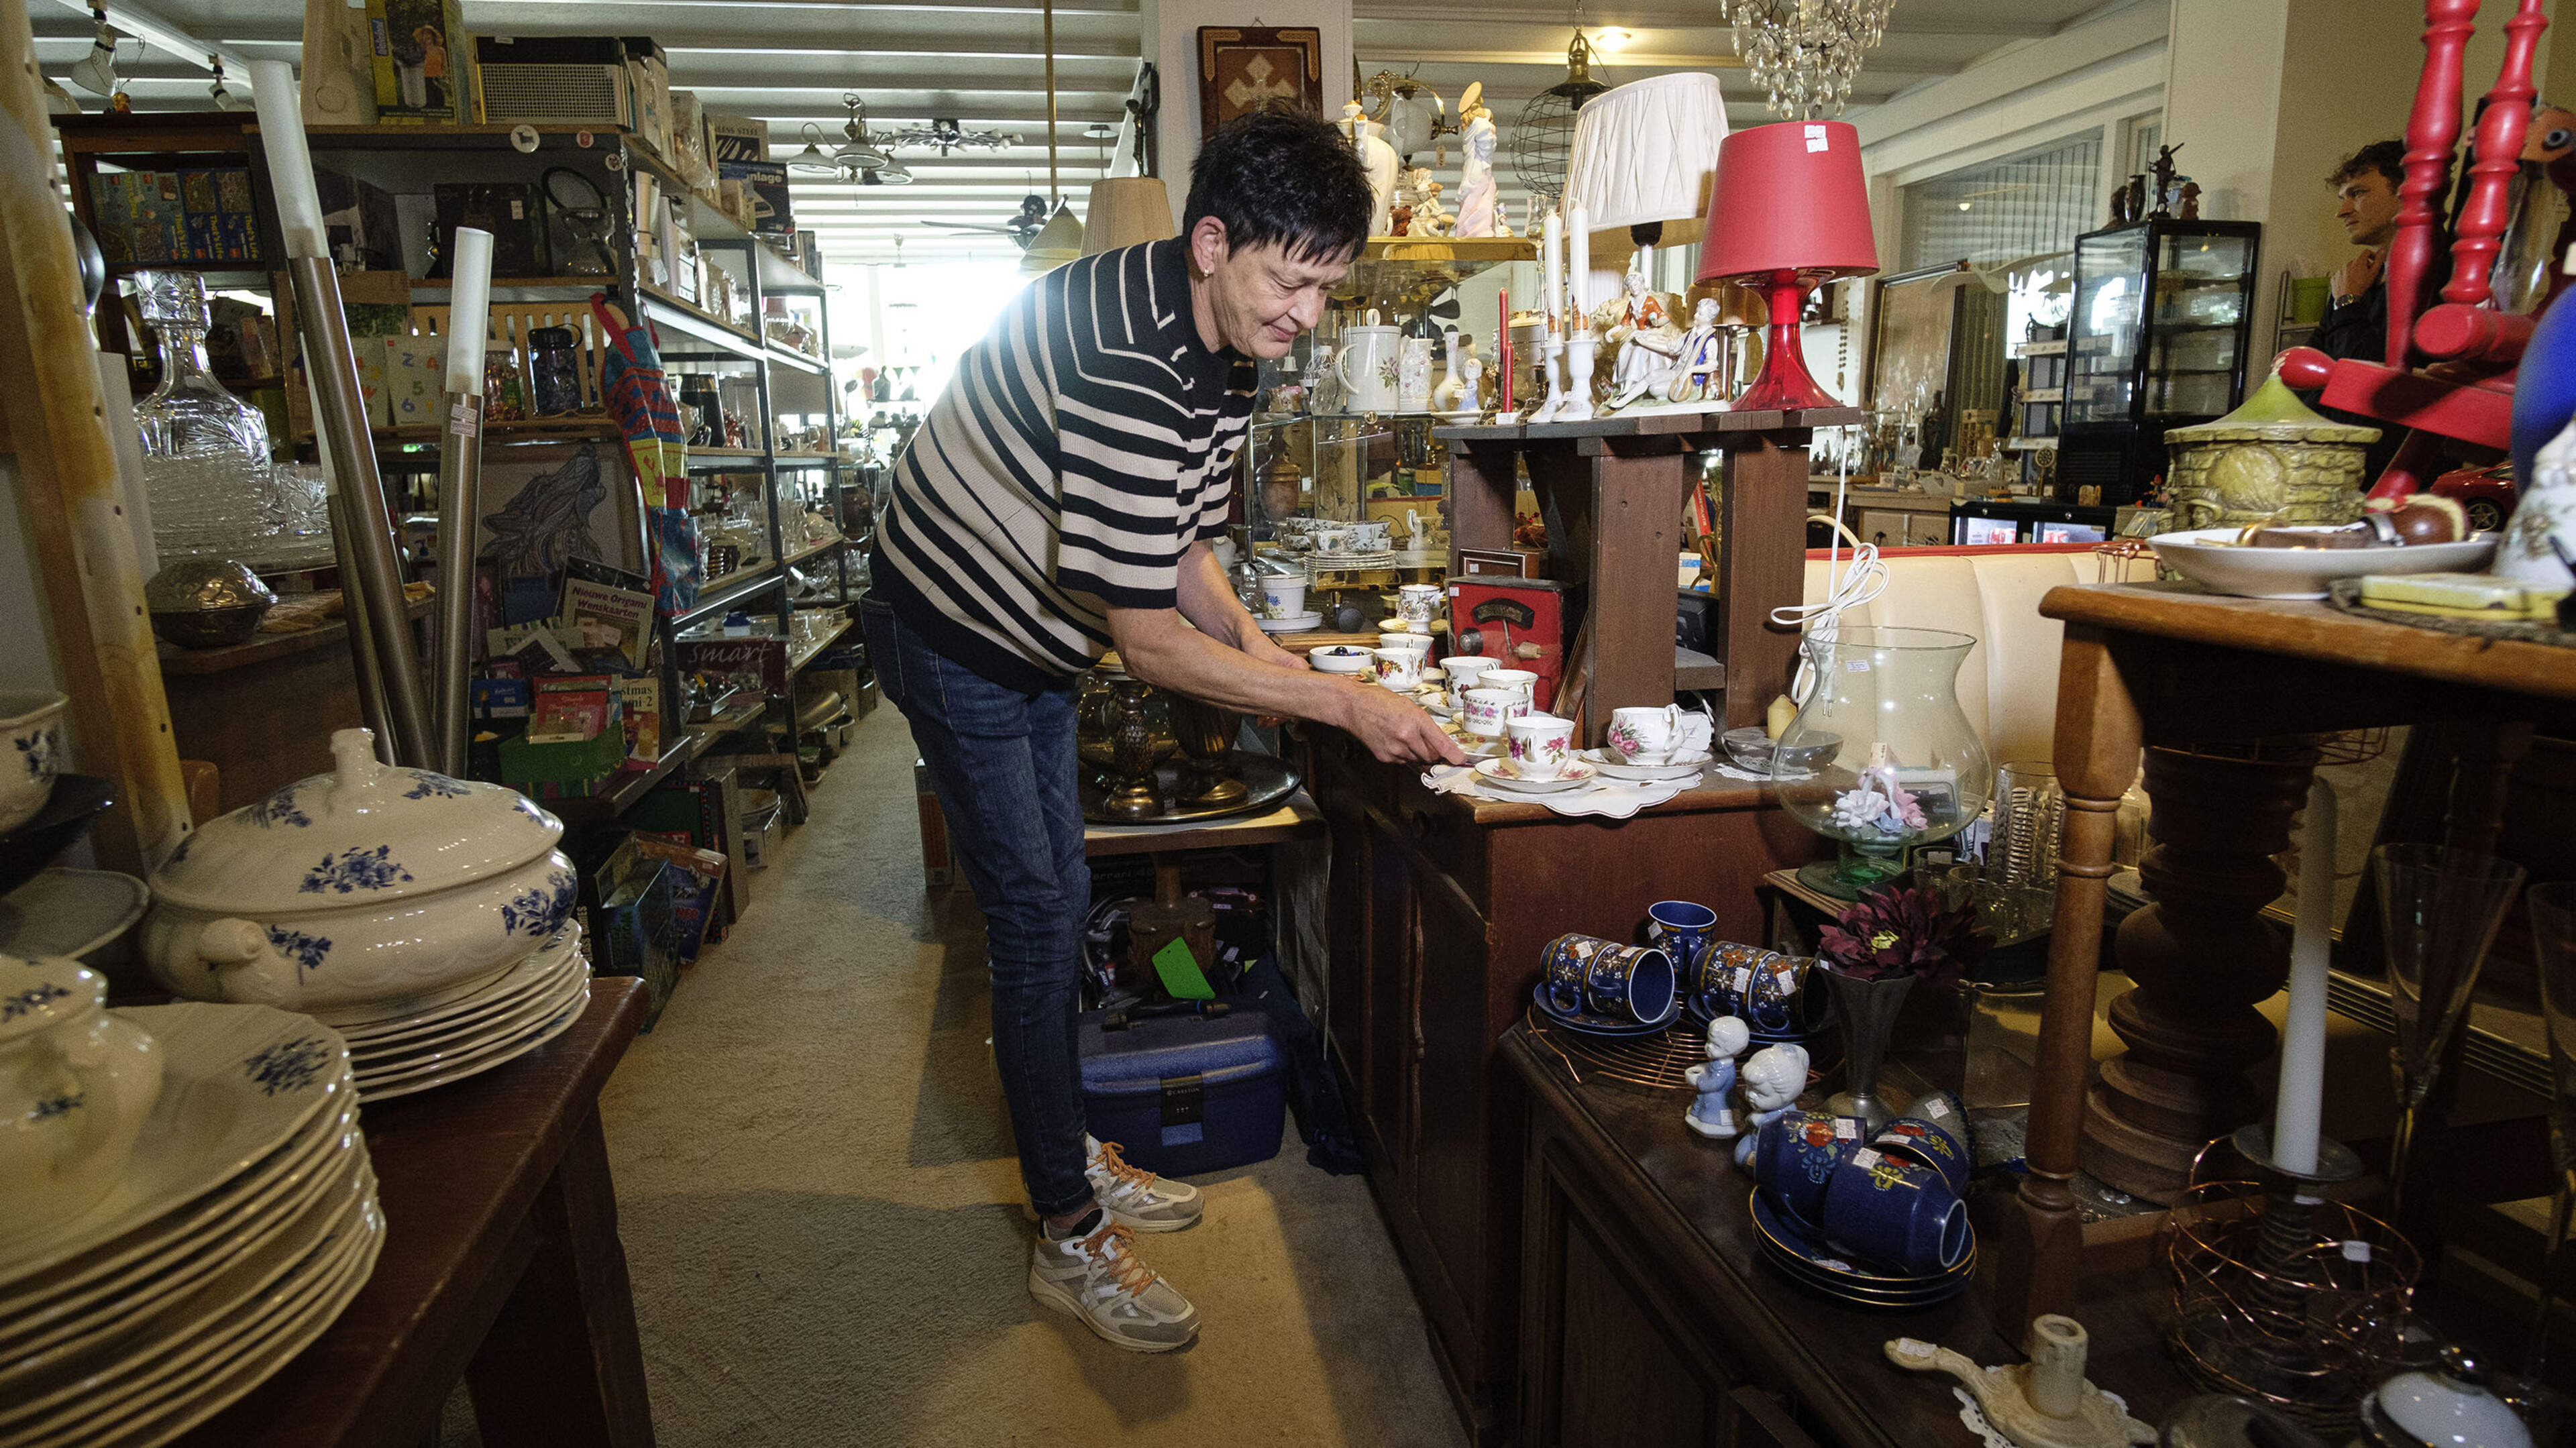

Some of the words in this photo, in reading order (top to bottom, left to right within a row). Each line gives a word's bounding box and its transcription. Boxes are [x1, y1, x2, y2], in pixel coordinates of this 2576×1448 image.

[209, 214, 221, 242] That's
[215, 242, 225, 260] Life
[244, 214, 255, 242] That's
[249, 242, 259, 260] Life
[401, 397, 416, 413] 6
[572, 586, 608, 601] Nieuwe
[610, 594, 647, 610] Origami
[577, 599, 639, 619] Wenskaarten
[688, 641, 771, 664] Smart
[646, 695, 653, 707] 2
[1092, 869, 1132, 881] errari
